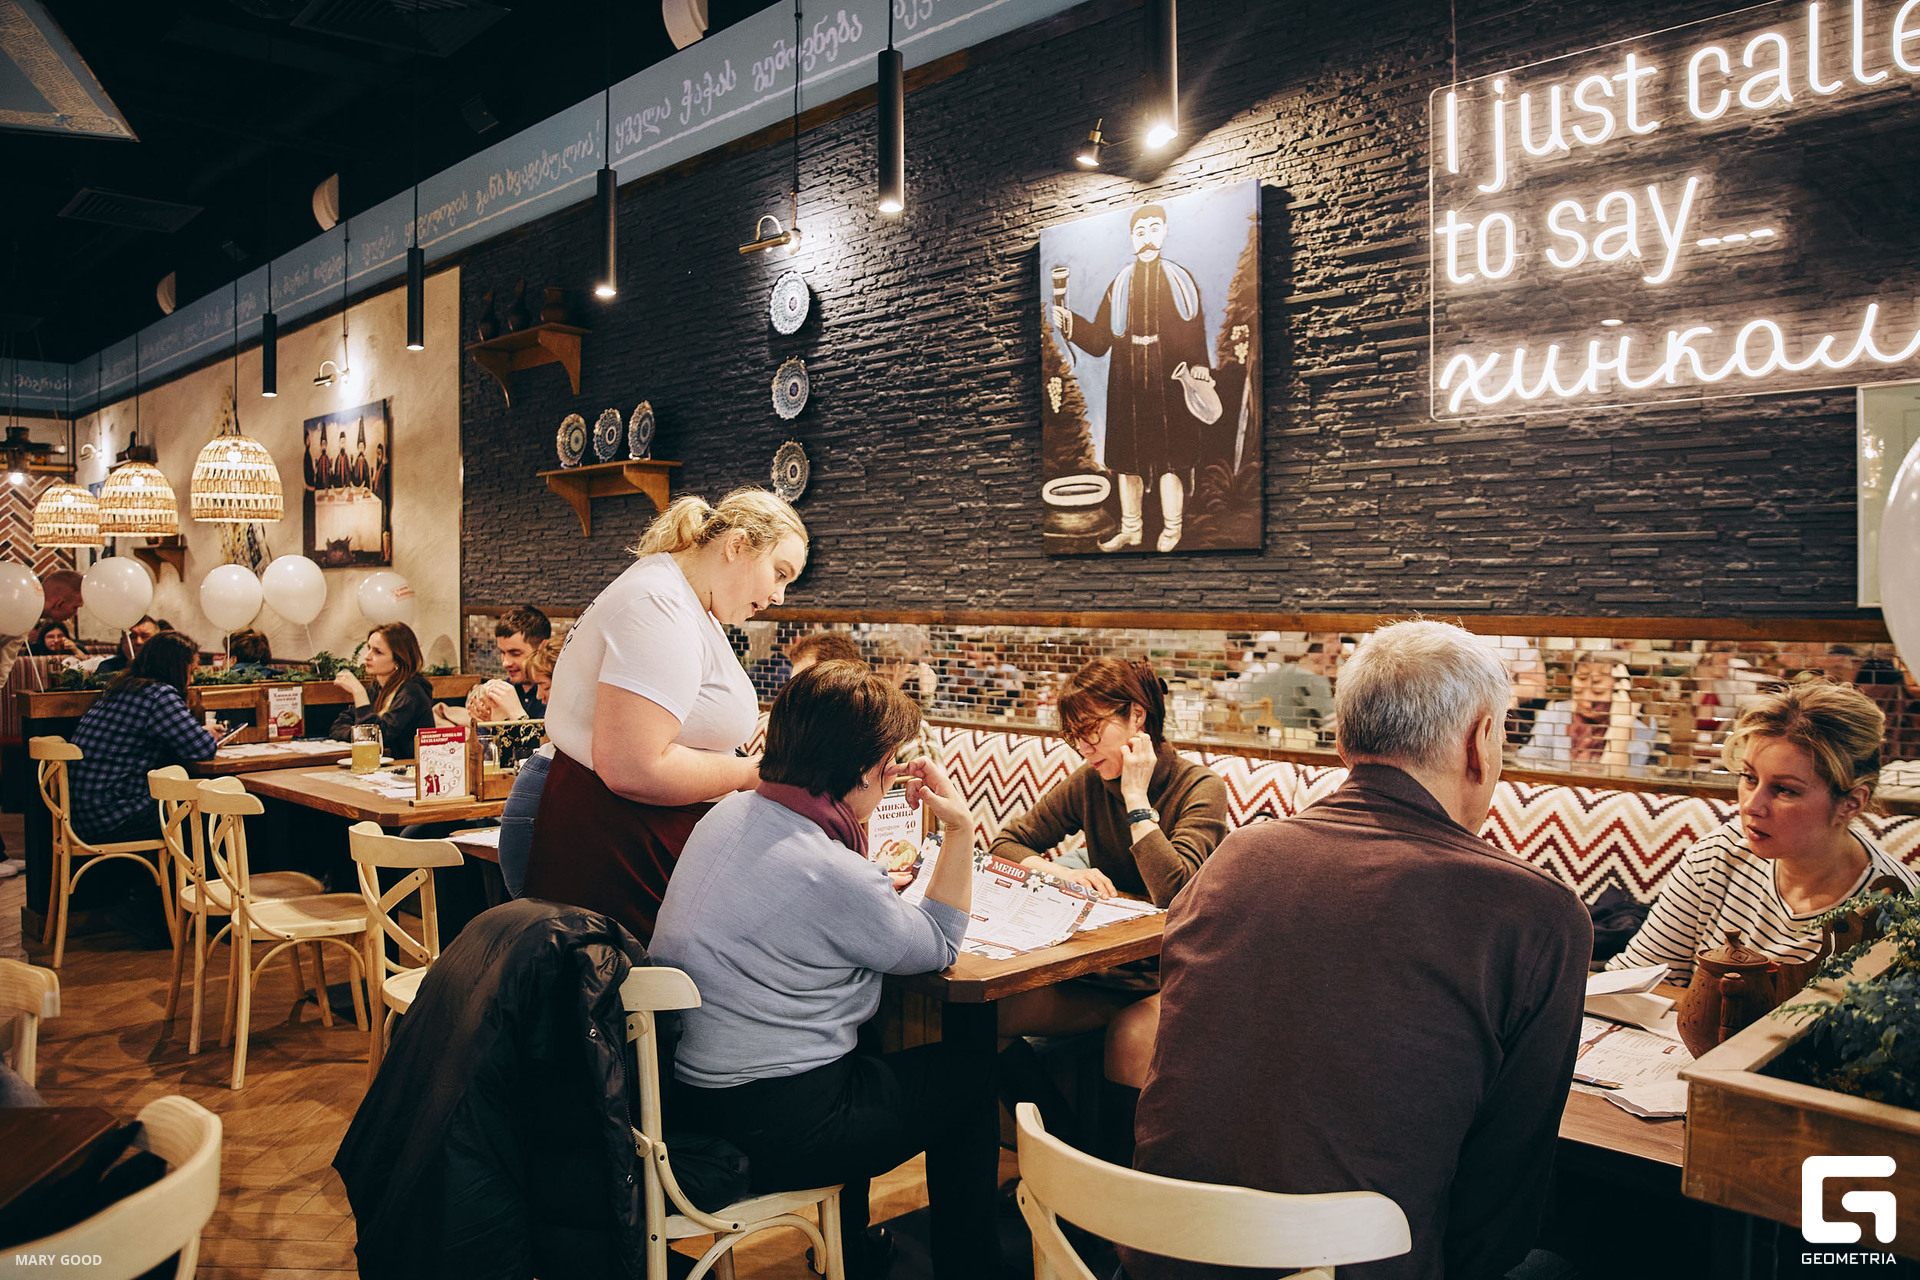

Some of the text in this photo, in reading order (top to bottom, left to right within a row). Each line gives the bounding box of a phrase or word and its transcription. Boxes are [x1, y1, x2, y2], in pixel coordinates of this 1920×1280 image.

[1446, 91, 1459, 174] I
[1478, 52, 1659, 193] just
[1434, 209, 1517, 284] to
[877, 810, 913, 820] месяца
[905, 820, 916, 829] 40
[992, 861, 1026, 879] МЕНЮ
